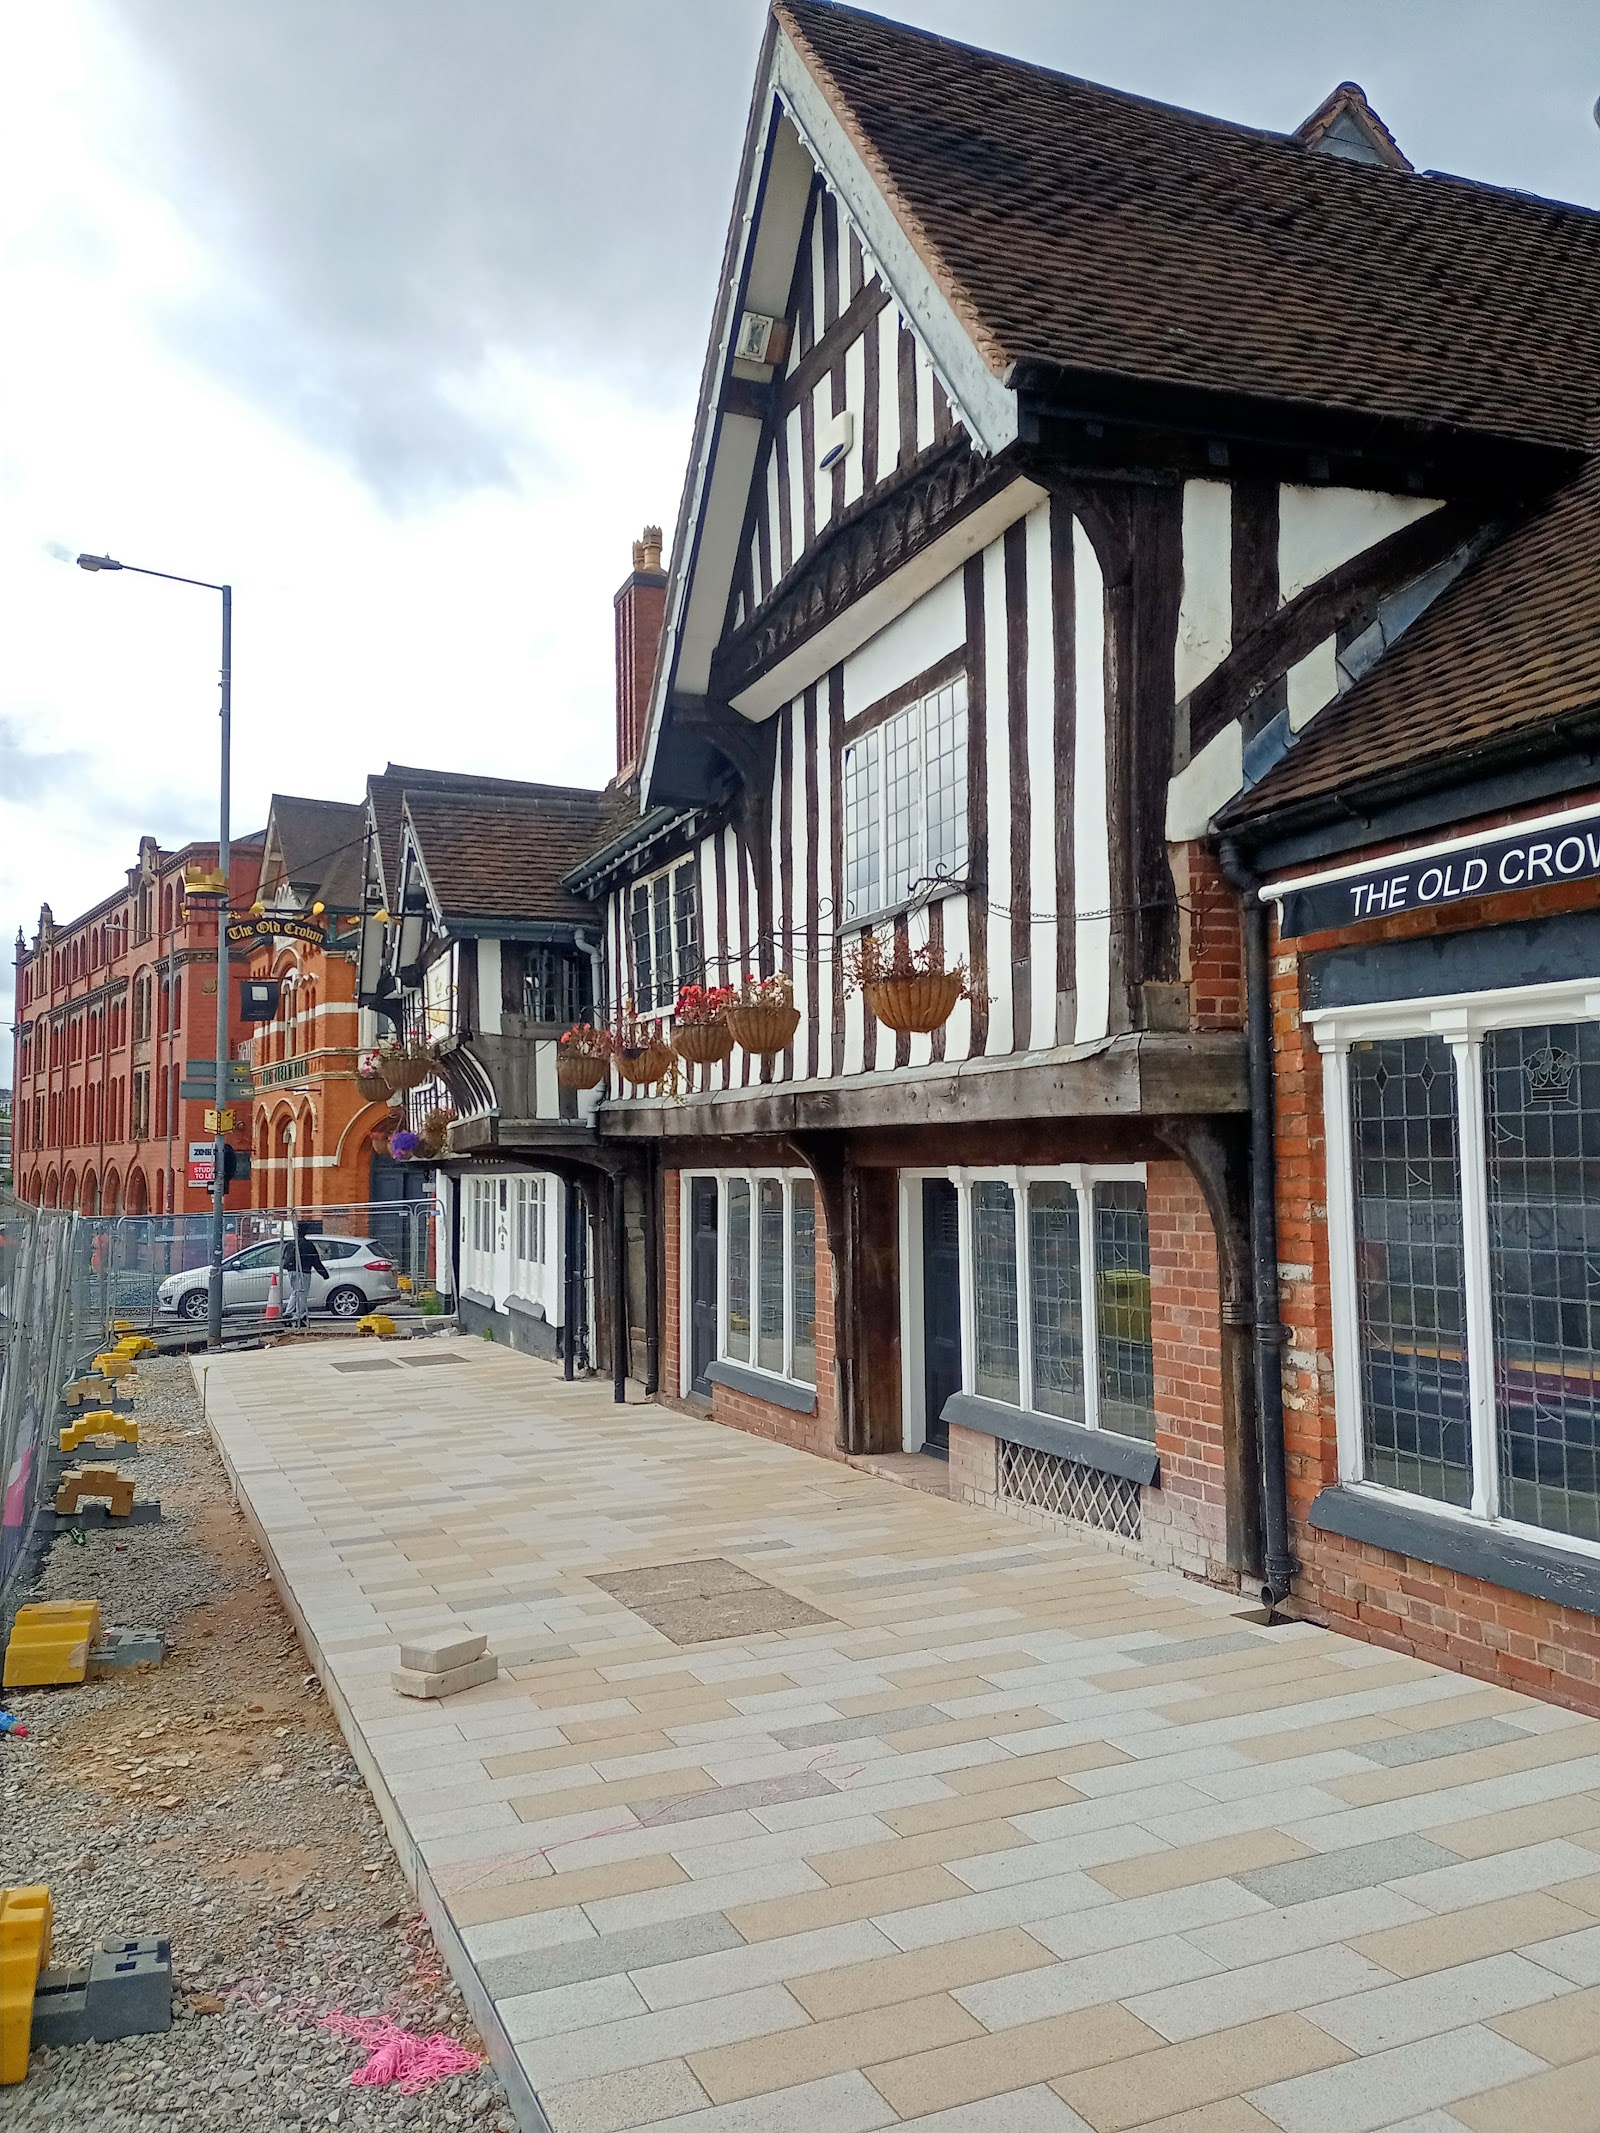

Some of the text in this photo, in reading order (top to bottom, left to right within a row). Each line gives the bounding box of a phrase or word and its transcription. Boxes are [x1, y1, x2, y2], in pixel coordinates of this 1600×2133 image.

[1350, 875, 1410, 917] THE
[1417, 859, 1487, 901] OLD
[227, 920, 324, 943] The Old Crown
